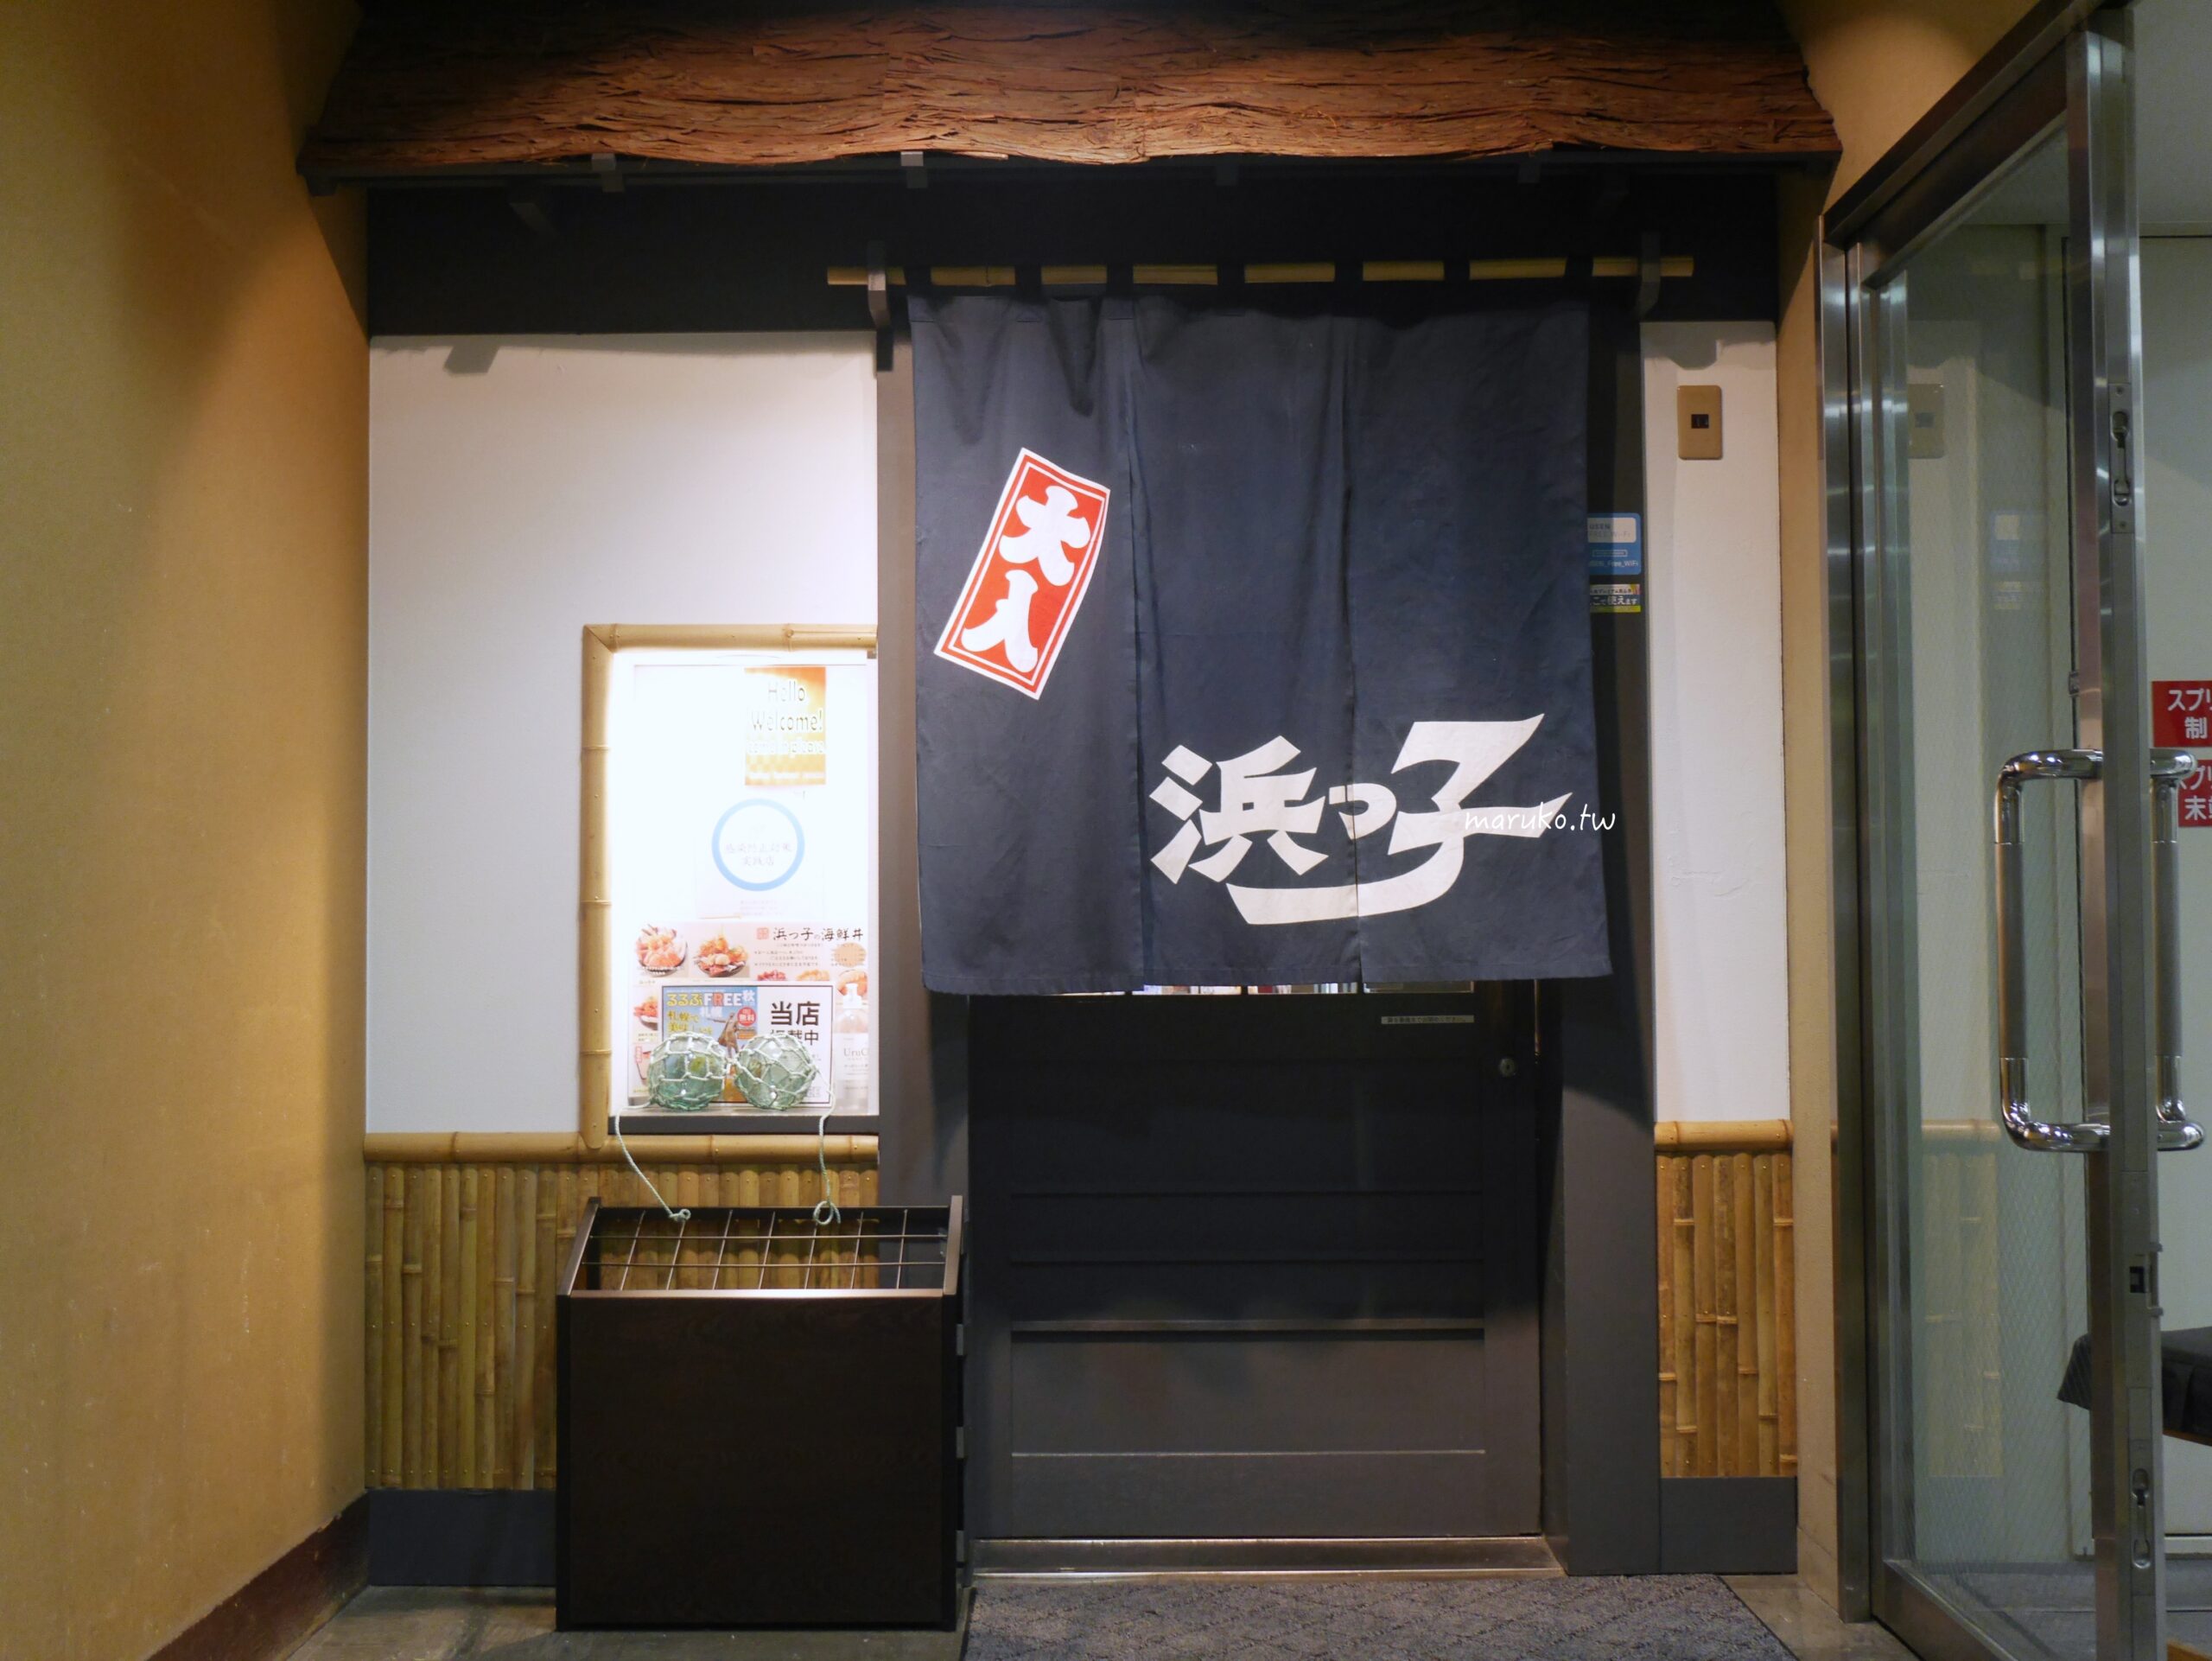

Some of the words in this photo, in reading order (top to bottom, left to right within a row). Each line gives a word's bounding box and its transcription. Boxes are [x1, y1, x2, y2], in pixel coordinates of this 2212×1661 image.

[768, 681, 806, 702] Hello
[751, 710, 823, 731] Welcome!
[2184, 716, 2208, 739] 制
[1149, 714, 1573, 925] 浜っ子
[771, 1001, 820, 1026] 当店
